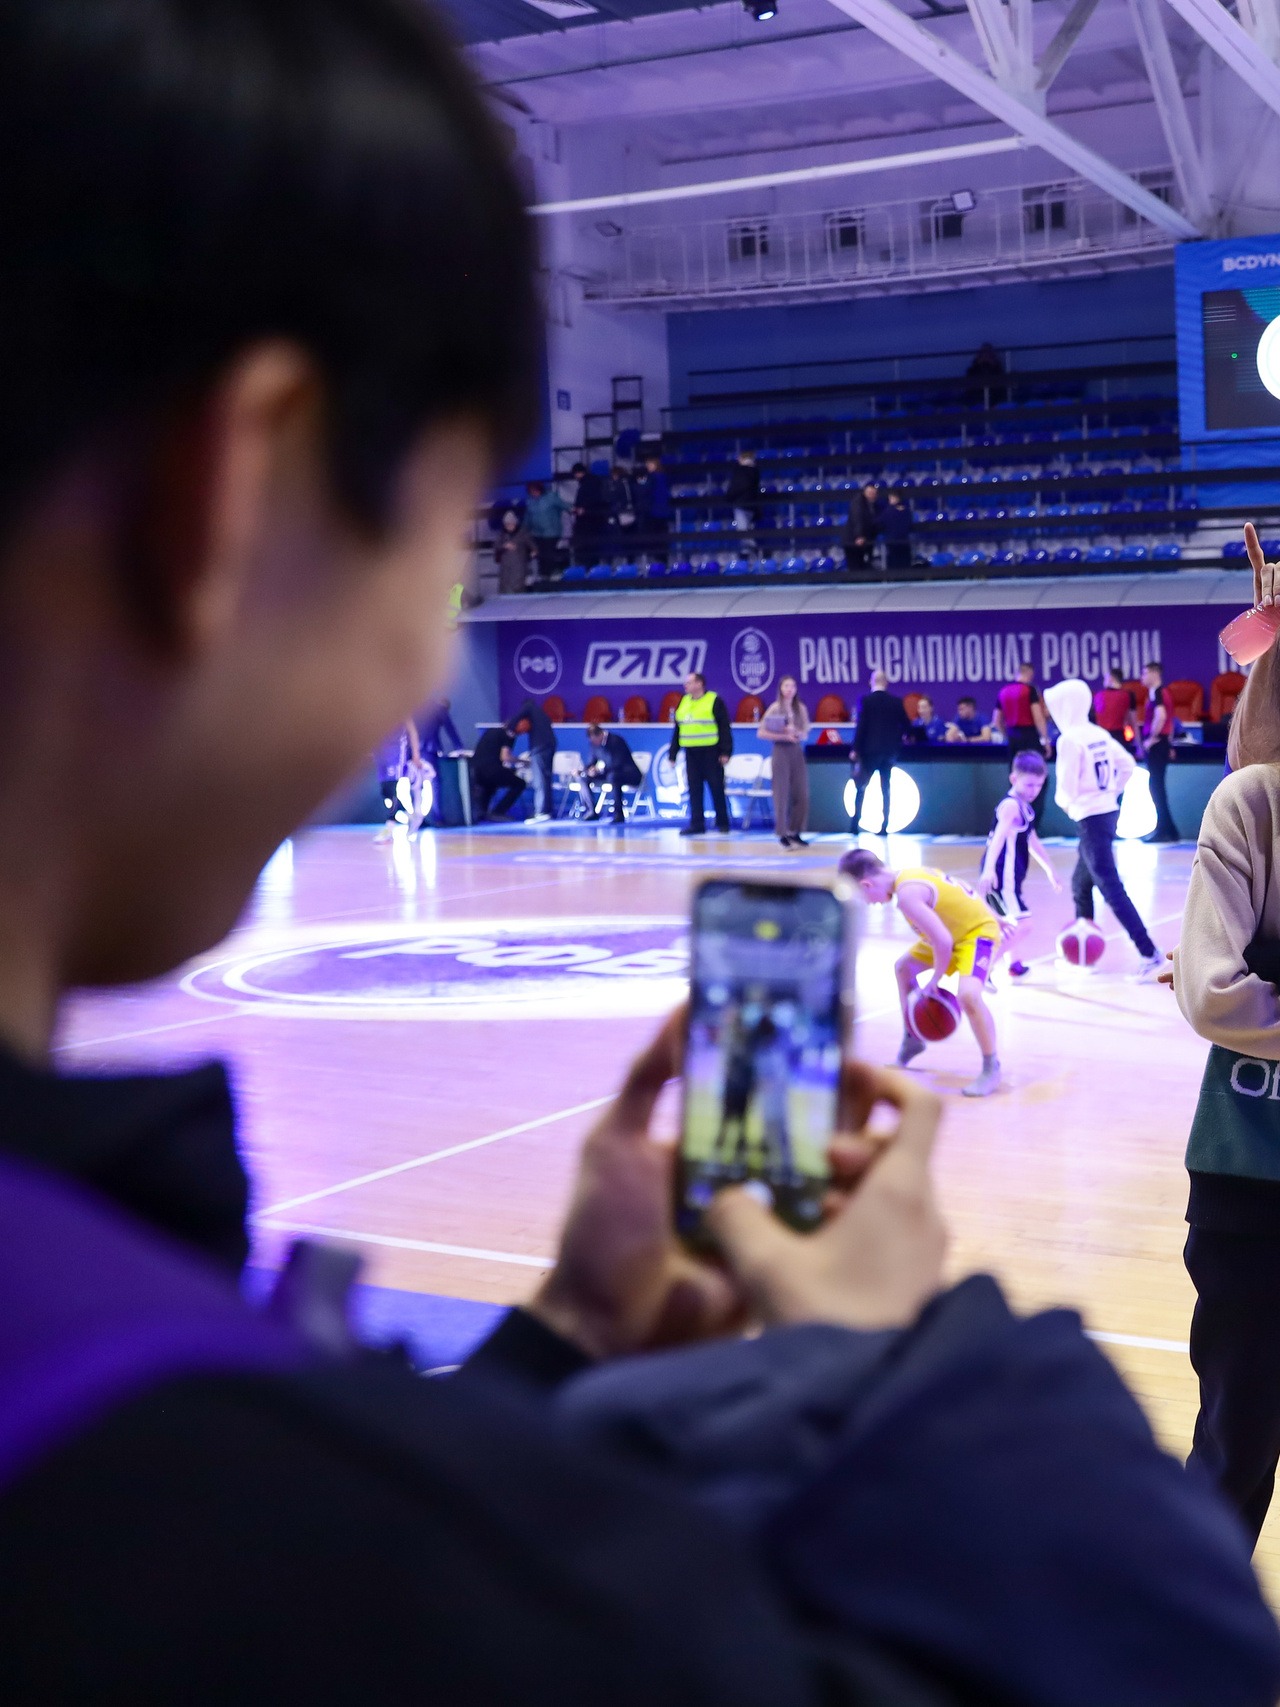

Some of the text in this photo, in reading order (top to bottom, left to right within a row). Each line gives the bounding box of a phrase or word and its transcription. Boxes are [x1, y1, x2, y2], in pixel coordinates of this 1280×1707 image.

[520, 656, 555, 673] РФБ
[589, 647, 699, 678] PARI
[799, 636, 859, 684] PARI
